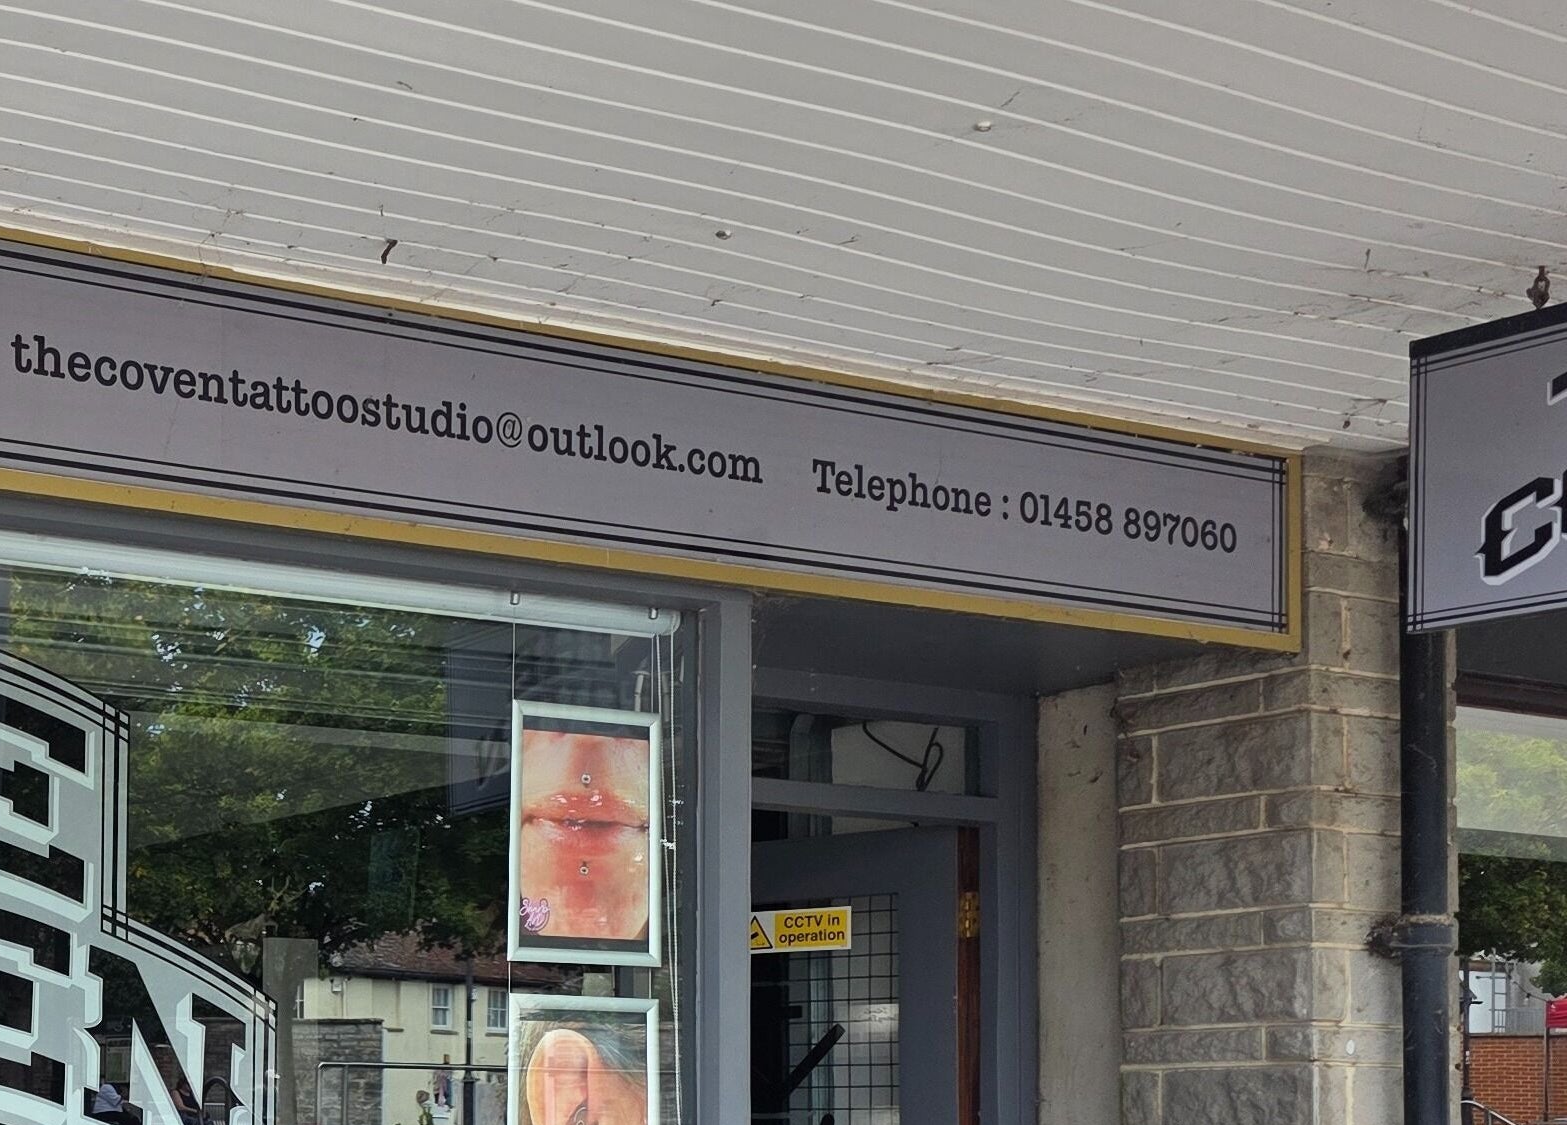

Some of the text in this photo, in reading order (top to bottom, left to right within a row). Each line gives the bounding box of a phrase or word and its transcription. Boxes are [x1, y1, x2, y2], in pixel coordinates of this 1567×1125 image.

[10, 333, 764, 484] thecoventattoostudio@outlook.com
[812, 458, 992, 517] Telephone
[1019, 491, 1113, 536] 01458
[1123, 507, 1237, 554] 897060
[778, 929, 845, 946] operation
[783, 914, 840, 929] CCTV in
